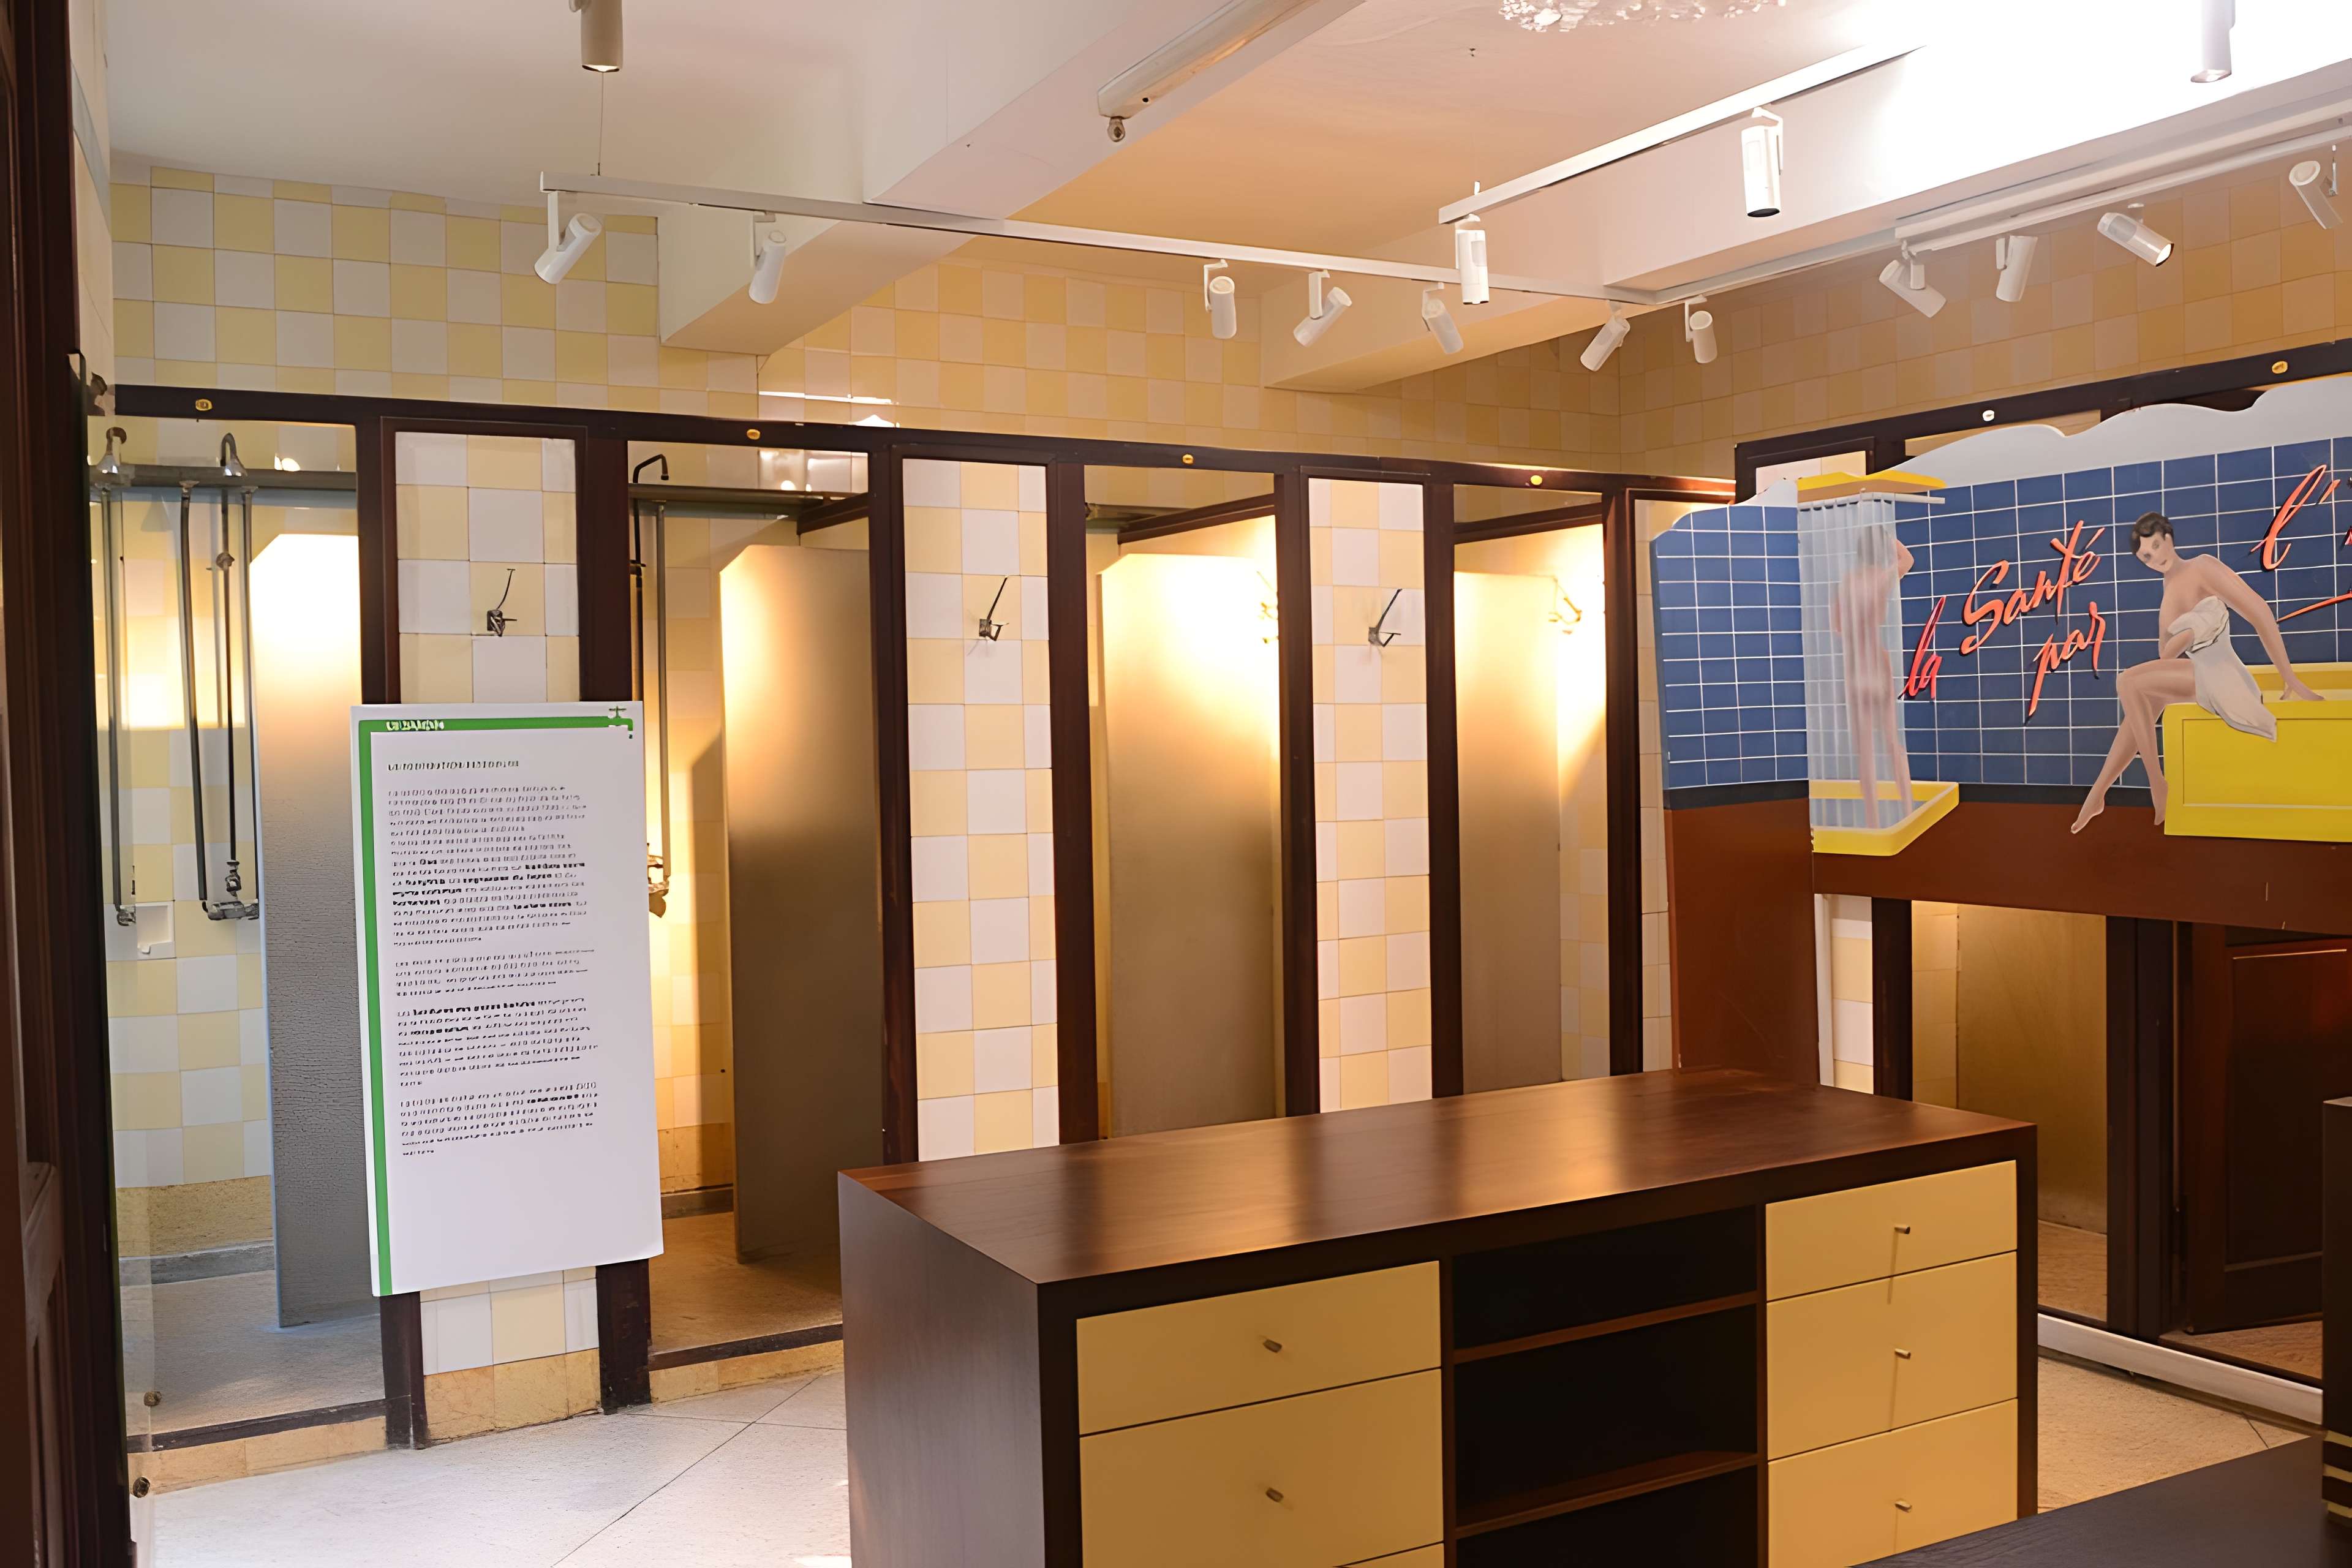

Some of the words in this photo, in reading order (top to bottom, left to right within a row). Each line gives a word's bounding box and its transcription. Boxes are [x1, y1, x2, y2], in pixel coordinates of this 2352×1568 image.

[2250, 464, 2352, 570] l'
[1899, 595, 1947, 699] la
[1960, 519, 2105, 654] Santé
[2027, 601, 2106, 717] par
